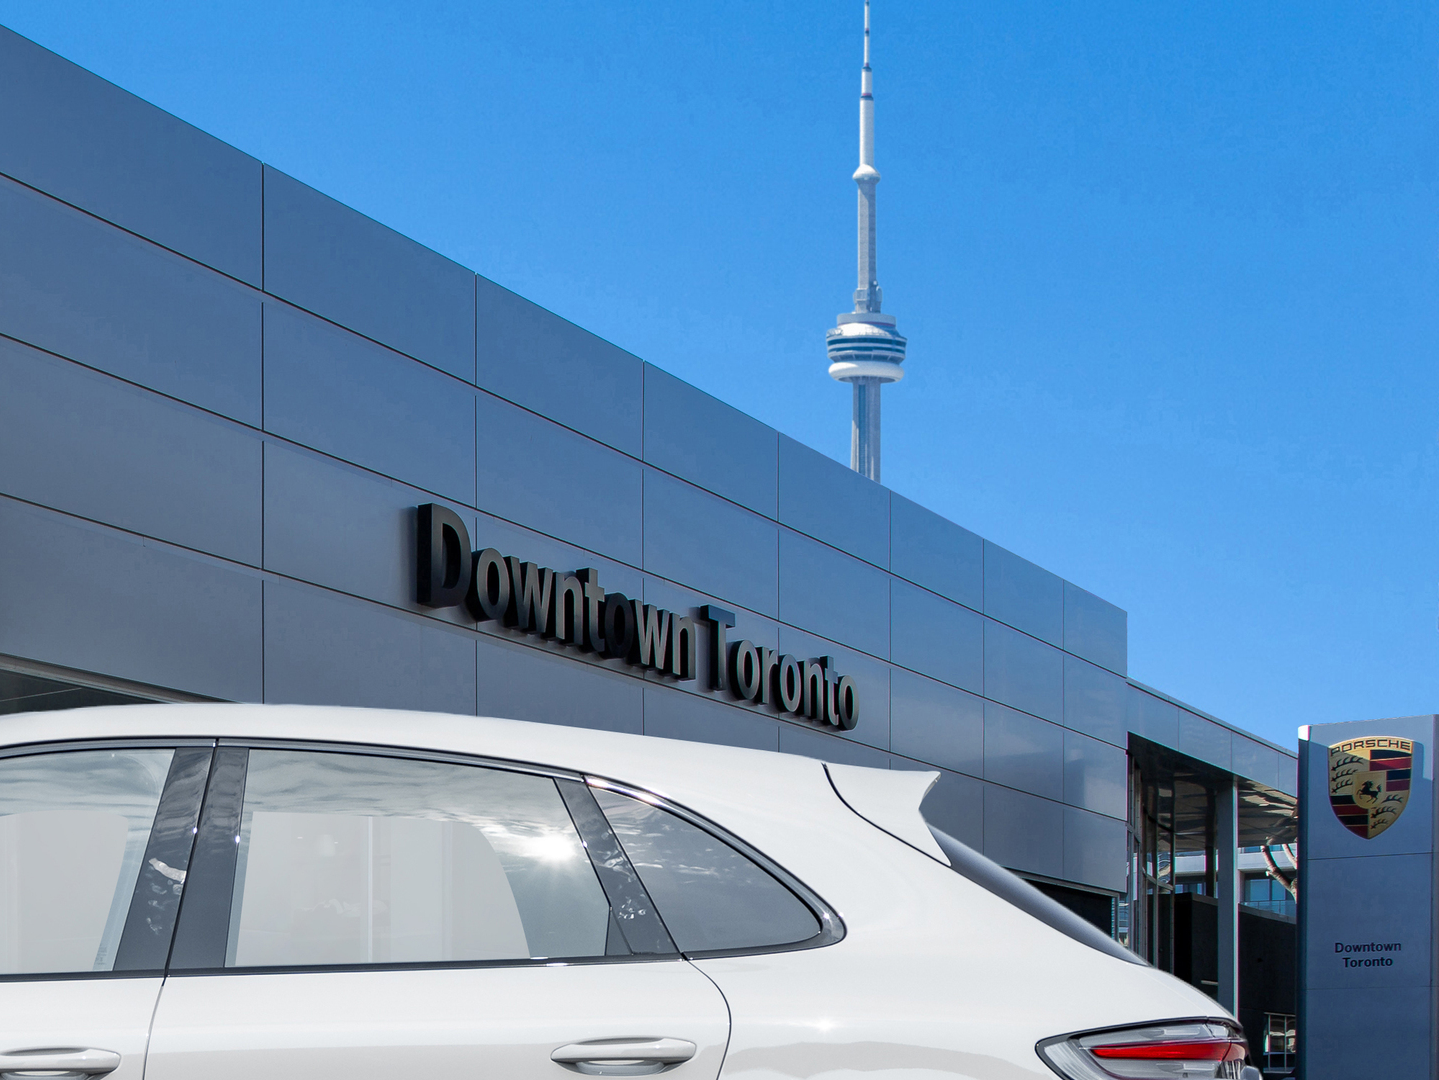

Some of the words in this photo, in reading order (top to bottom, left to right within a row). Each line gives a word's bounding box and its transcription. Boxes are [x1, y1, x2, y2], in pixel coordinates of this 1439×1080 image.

[416, 502, 696, 682] Downtown
[699, 603, 860, 731] Toronto
[1330, 739, 1411, 757] PORSCHE
[1333, 941, 1402, 955] Downtown
[1342, 957, 1394, 968] Toronto
